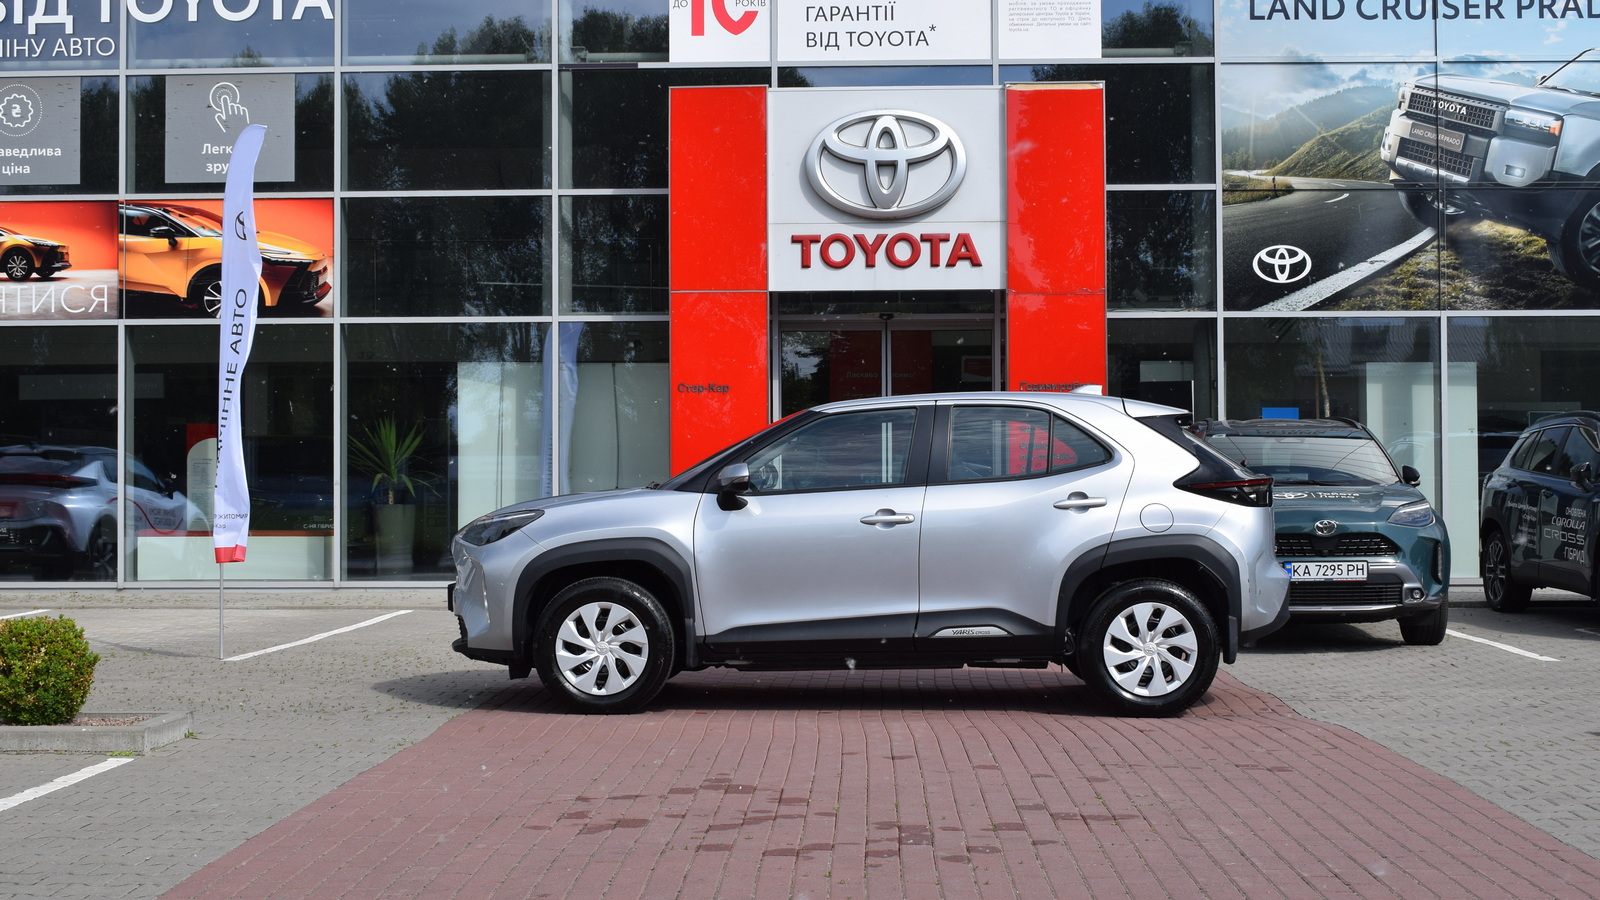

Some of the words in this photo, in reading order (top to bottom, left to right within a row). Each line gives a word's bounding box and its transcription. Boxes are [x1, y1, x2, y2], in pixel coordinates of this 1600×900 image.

[806, 1, 896, 21] ГАРАНТІЇ
[1249, 0, 1345, 21] LAND
[1356, 0, 1506, 20] CRUISER
[0, 38, 46, 58] ІНУ
[52, 37, 115, 56] АВТО
[806, 31, 840, 51] ВІД
[1432, 100, 1467, 115] TOYOTA
[1411, 127, 1424, 136] LAND
[0, 147, 62, 158] аведлива
[201, 143, 233, 154] Легк
[2, 162, 31, 176] ціна
[205, 163, 230, 174] зру
[791, 233, 983, 268] TOYOTA
[229, 288, 248, 355] АВТО
[677, 383, 731, 394] Стар-Кар
[1020, 381, 1058, 392] Години
[218, 512, 249, 520] ЖИТОМИР
[1551, 516, 1586, 531] COROLLA
[1543, 527, 1585, 546] CROSS
[1292, 564, 1312, 577] KA
[1315, 564, 1344, 577] 7295
[1346, 563, 1365, 576] PH
[951, 628, 976, 636] YARIS
